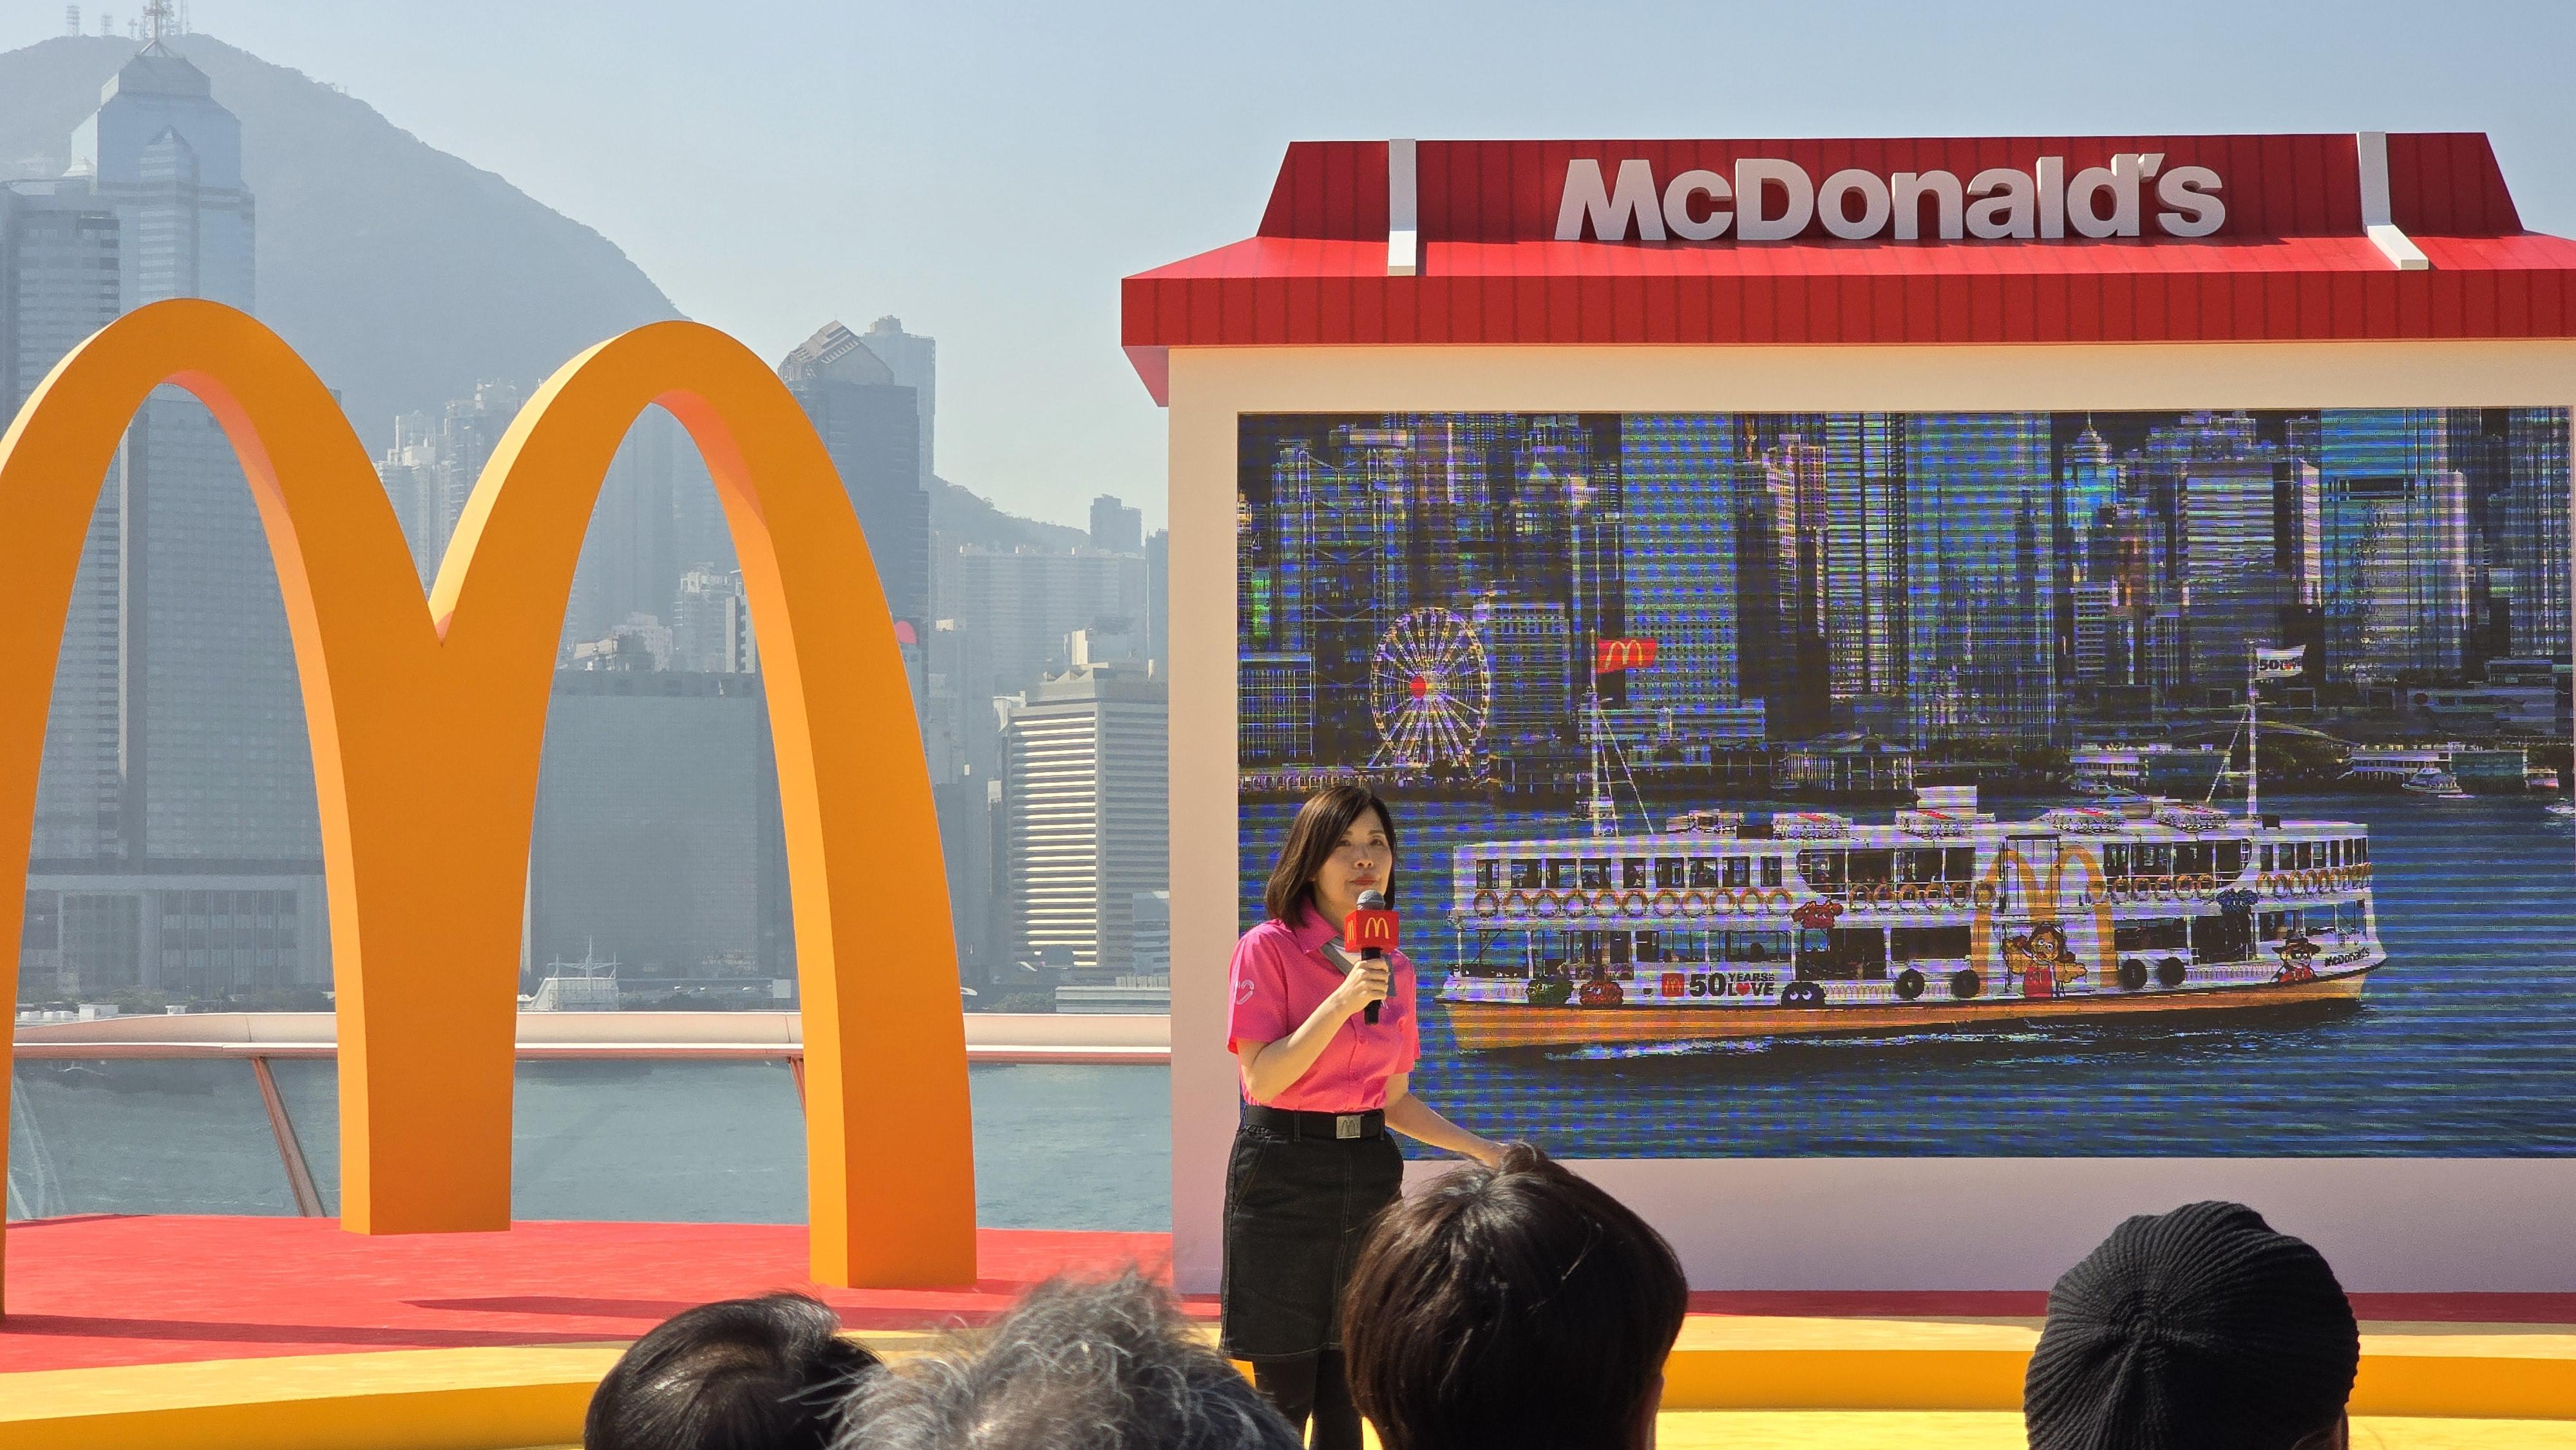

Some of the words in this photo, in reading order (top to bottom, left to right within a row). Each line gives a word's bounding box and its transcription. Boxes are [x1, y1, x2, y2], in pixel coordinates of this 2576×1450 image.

[1555, 153, 2226, 241] McDonald's
[1689, 973, 1727, 997] 50
[1728, 973, 1768, 982] YEARS
